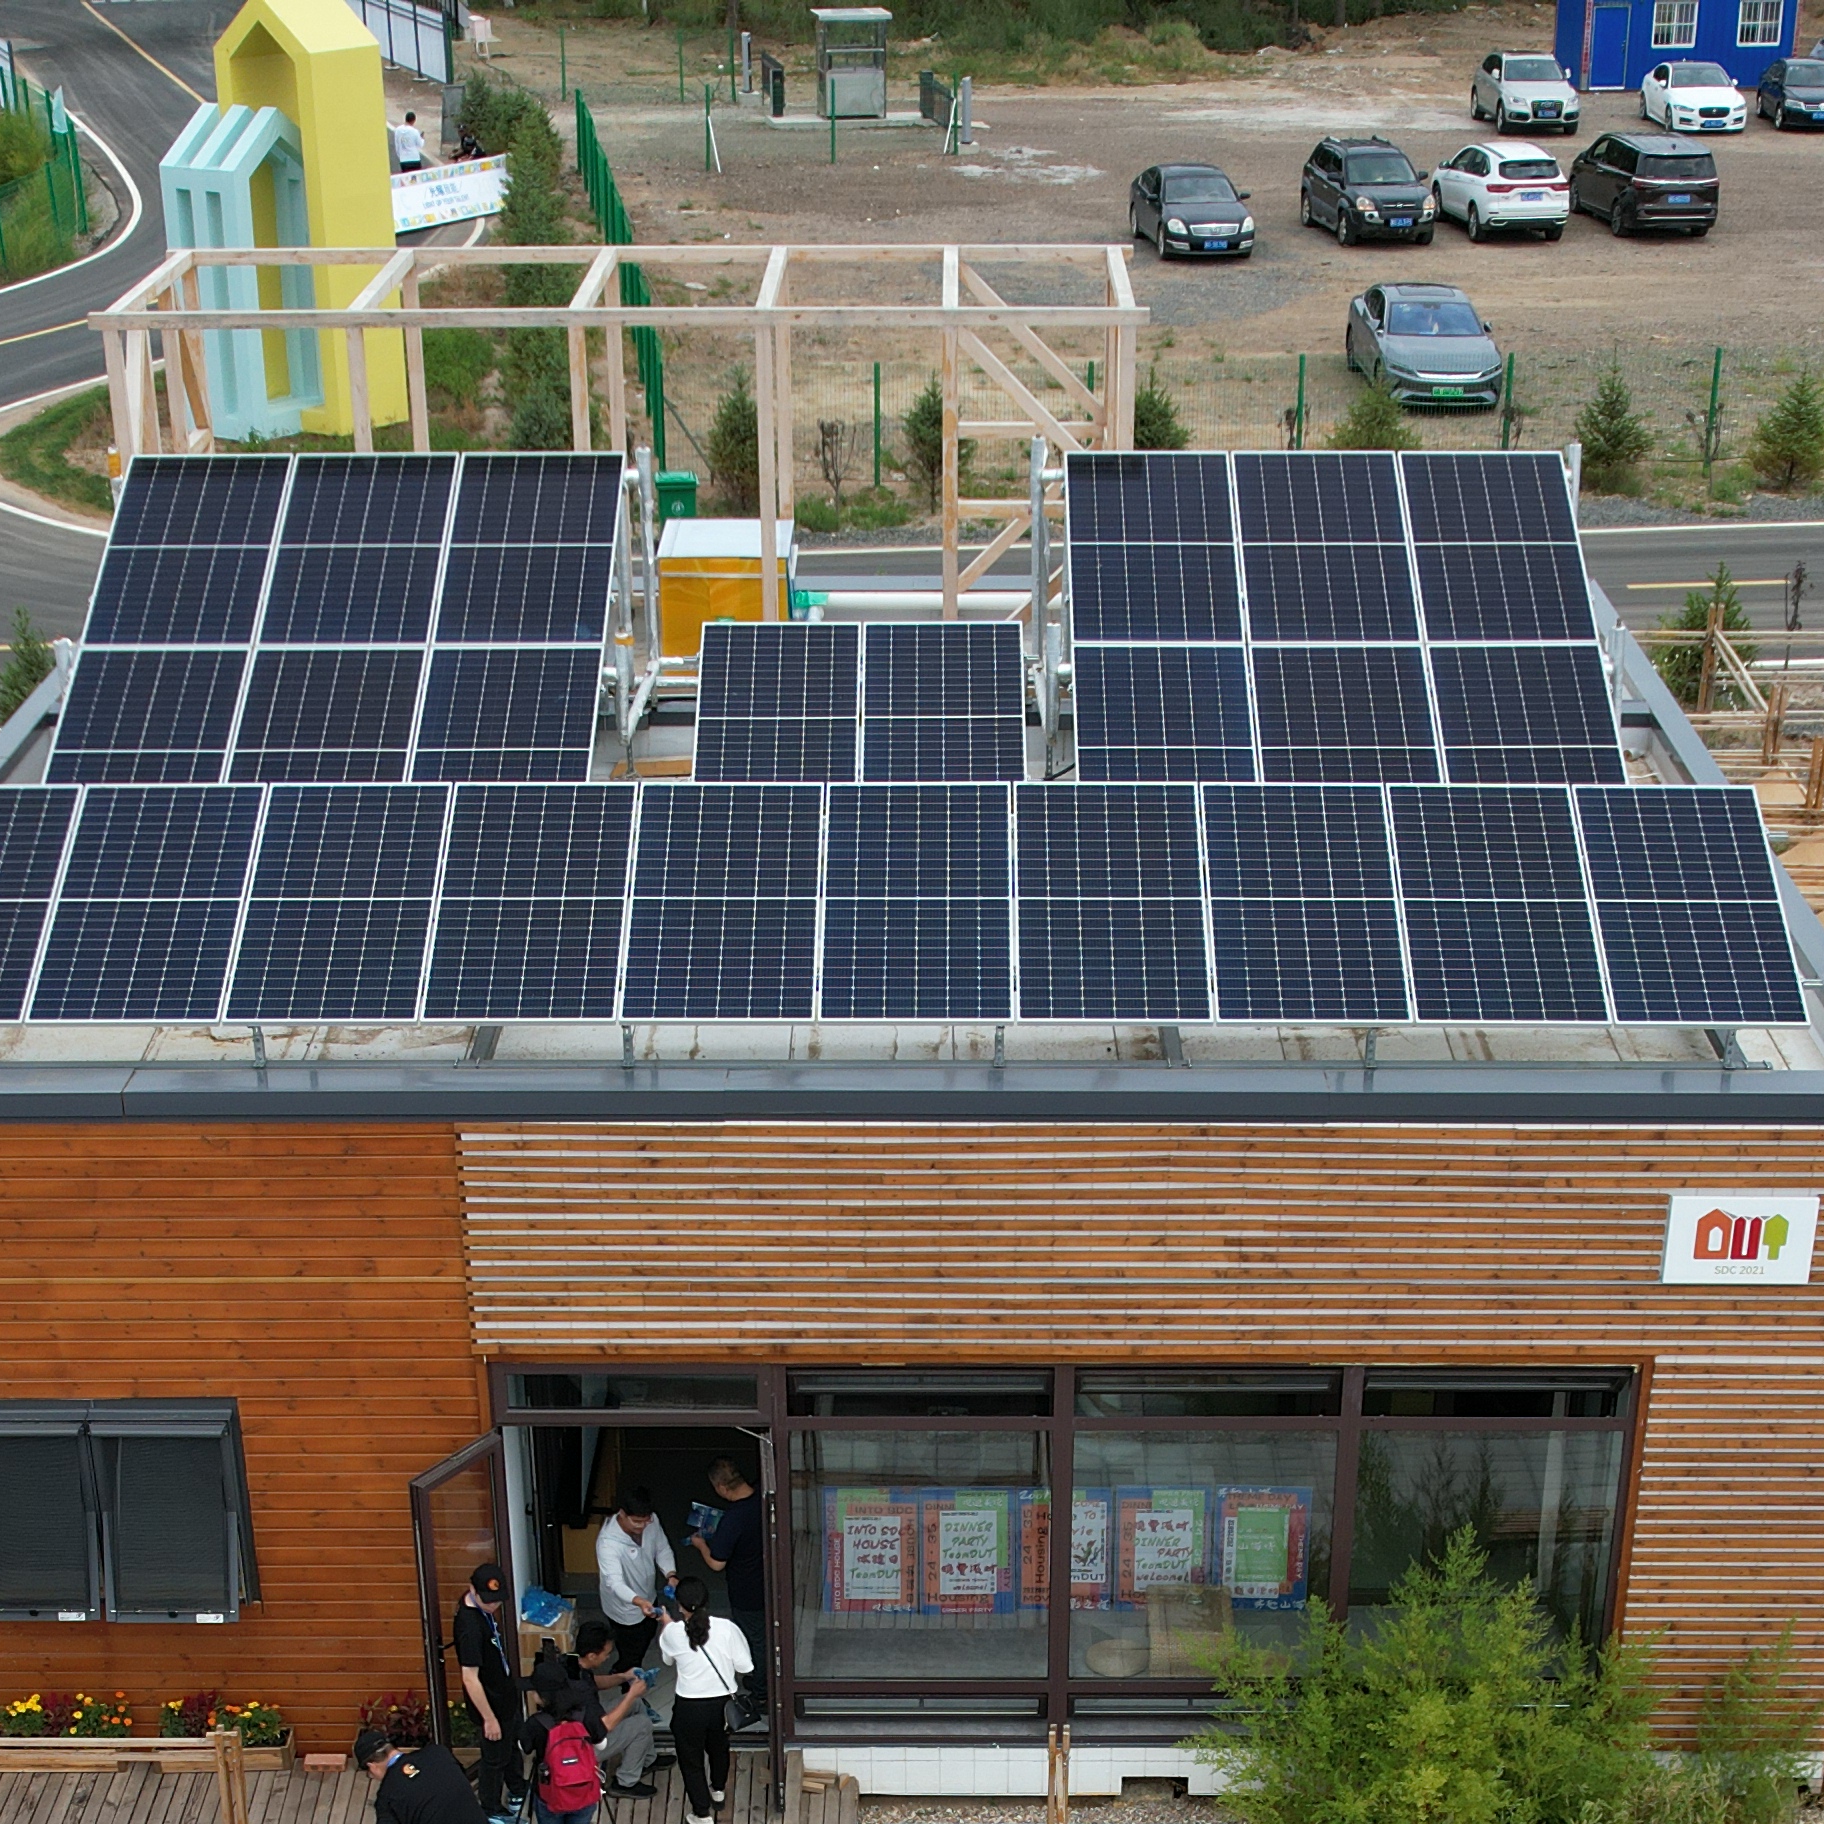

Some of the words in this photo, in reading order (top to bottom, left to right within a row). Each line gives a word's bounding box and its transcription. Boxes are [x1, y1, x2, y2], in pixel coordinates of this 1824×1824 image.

[1714, 1265, 1737, 1275] SDC
[1739, 1265, 1765, 1275] 2021
[847, 1525, 876, 1535] INTO
[944, 1521, 993, 1532] DINNER
[853, 1538, 900, 1550] HOUSE
[951, 1535, 988, 1547] PARTY
[1134, 1537, 1181, 1547] DINNER
[1035, 1527, 1049, 1584] Housing
[1157, 1548, 1193, 1558] PARTY
[927, 1593, 989, 1605] Housing
